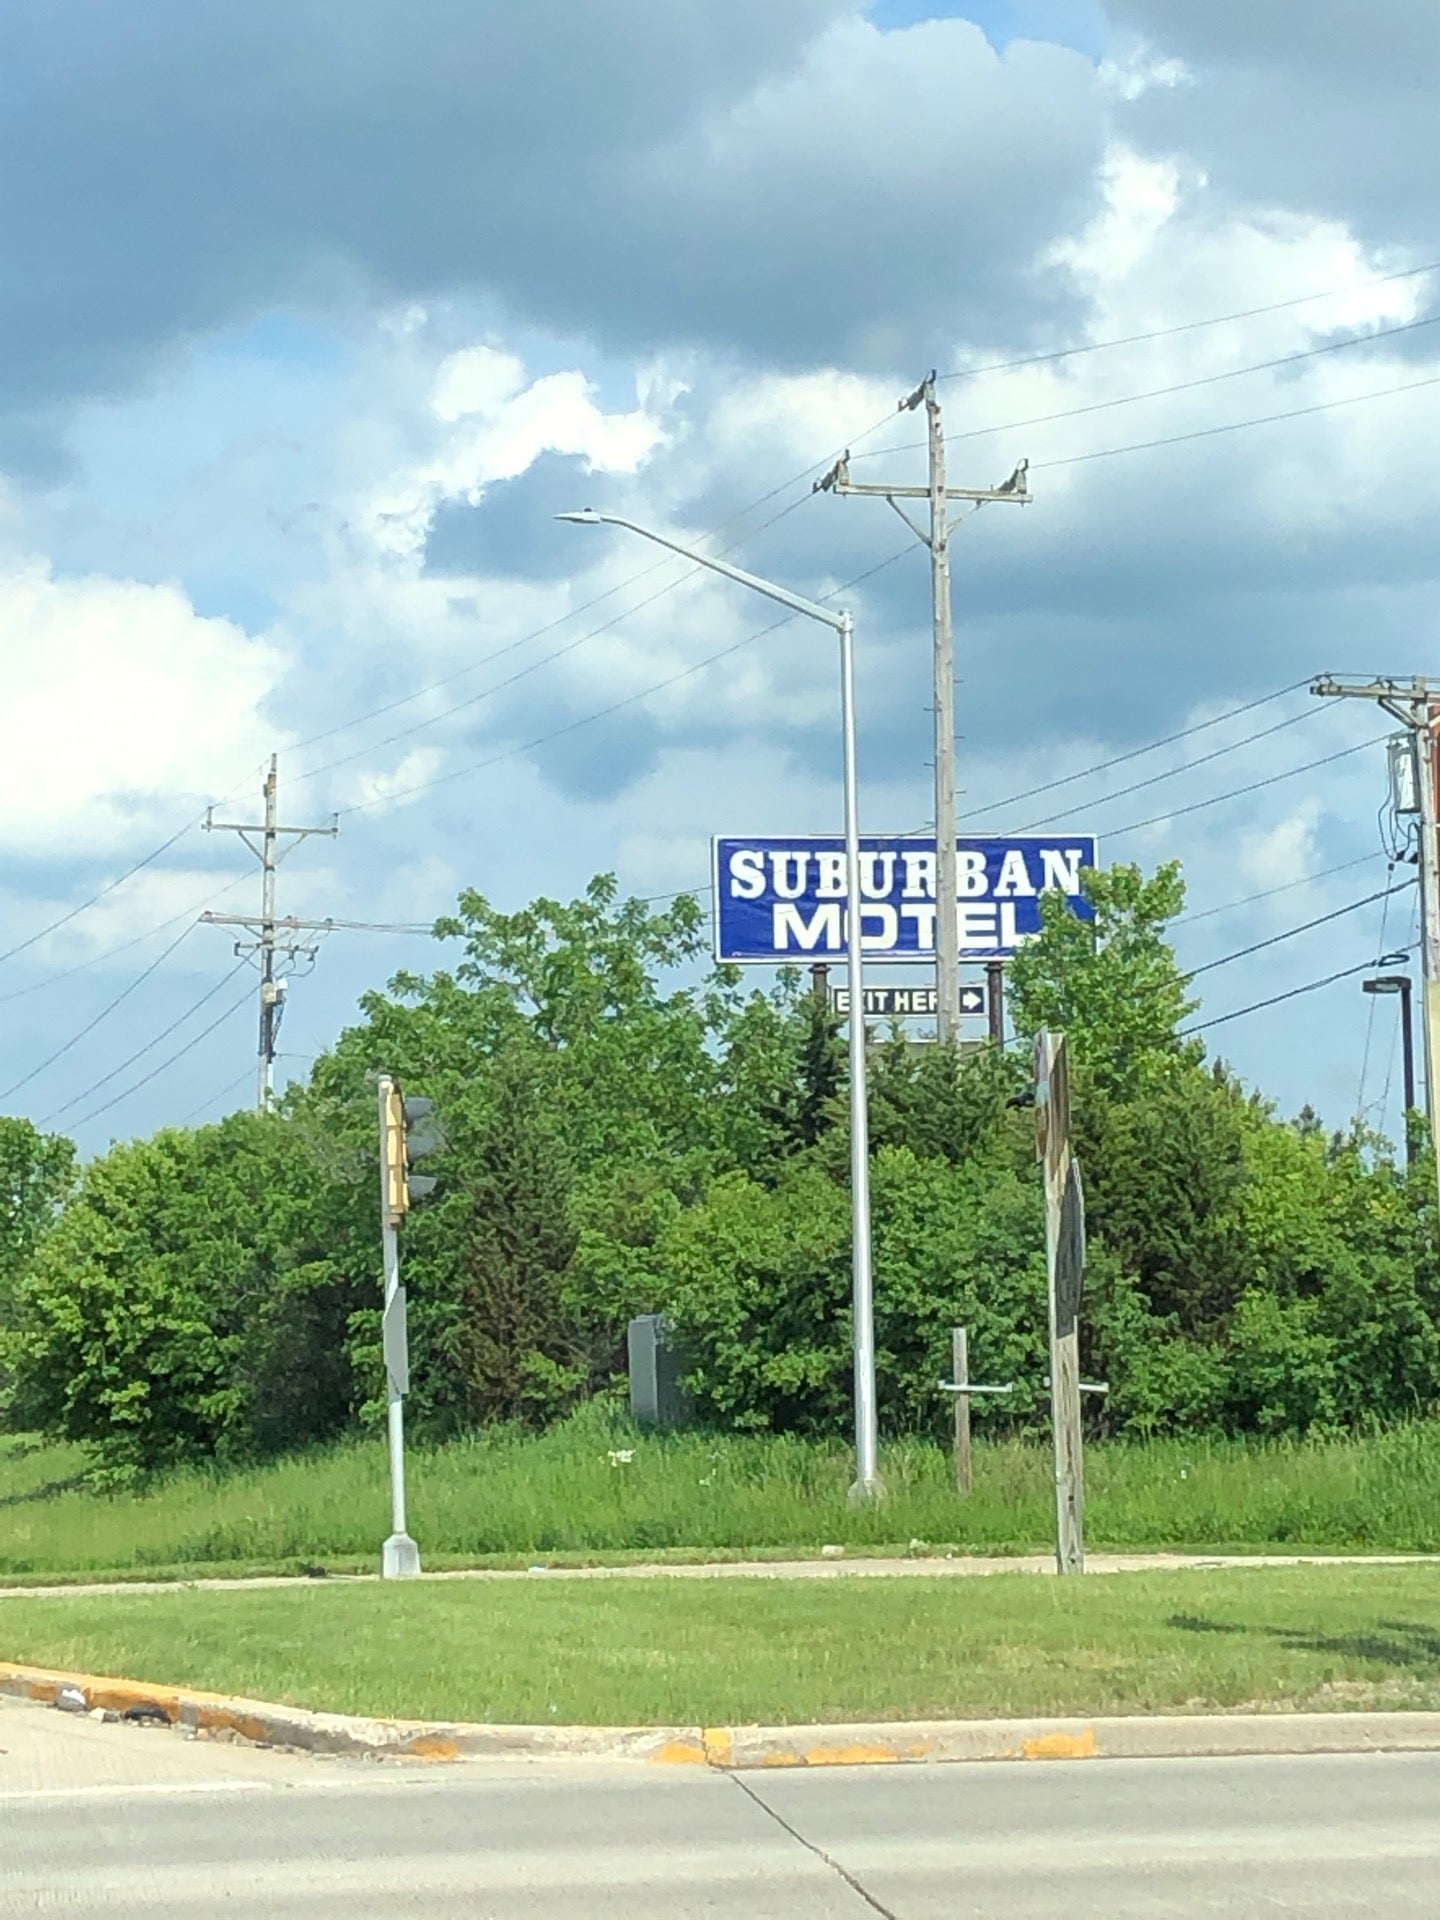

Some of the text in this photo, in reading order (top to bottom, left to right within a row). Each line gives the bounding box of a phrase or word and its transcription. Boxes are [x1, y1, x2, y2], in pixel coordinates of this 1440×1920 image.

[729, 850, 1083, 898] SUBURBAN
[773, 902, 1041, 950] MOTEL
[837, 991, 889, 1012] EIT
